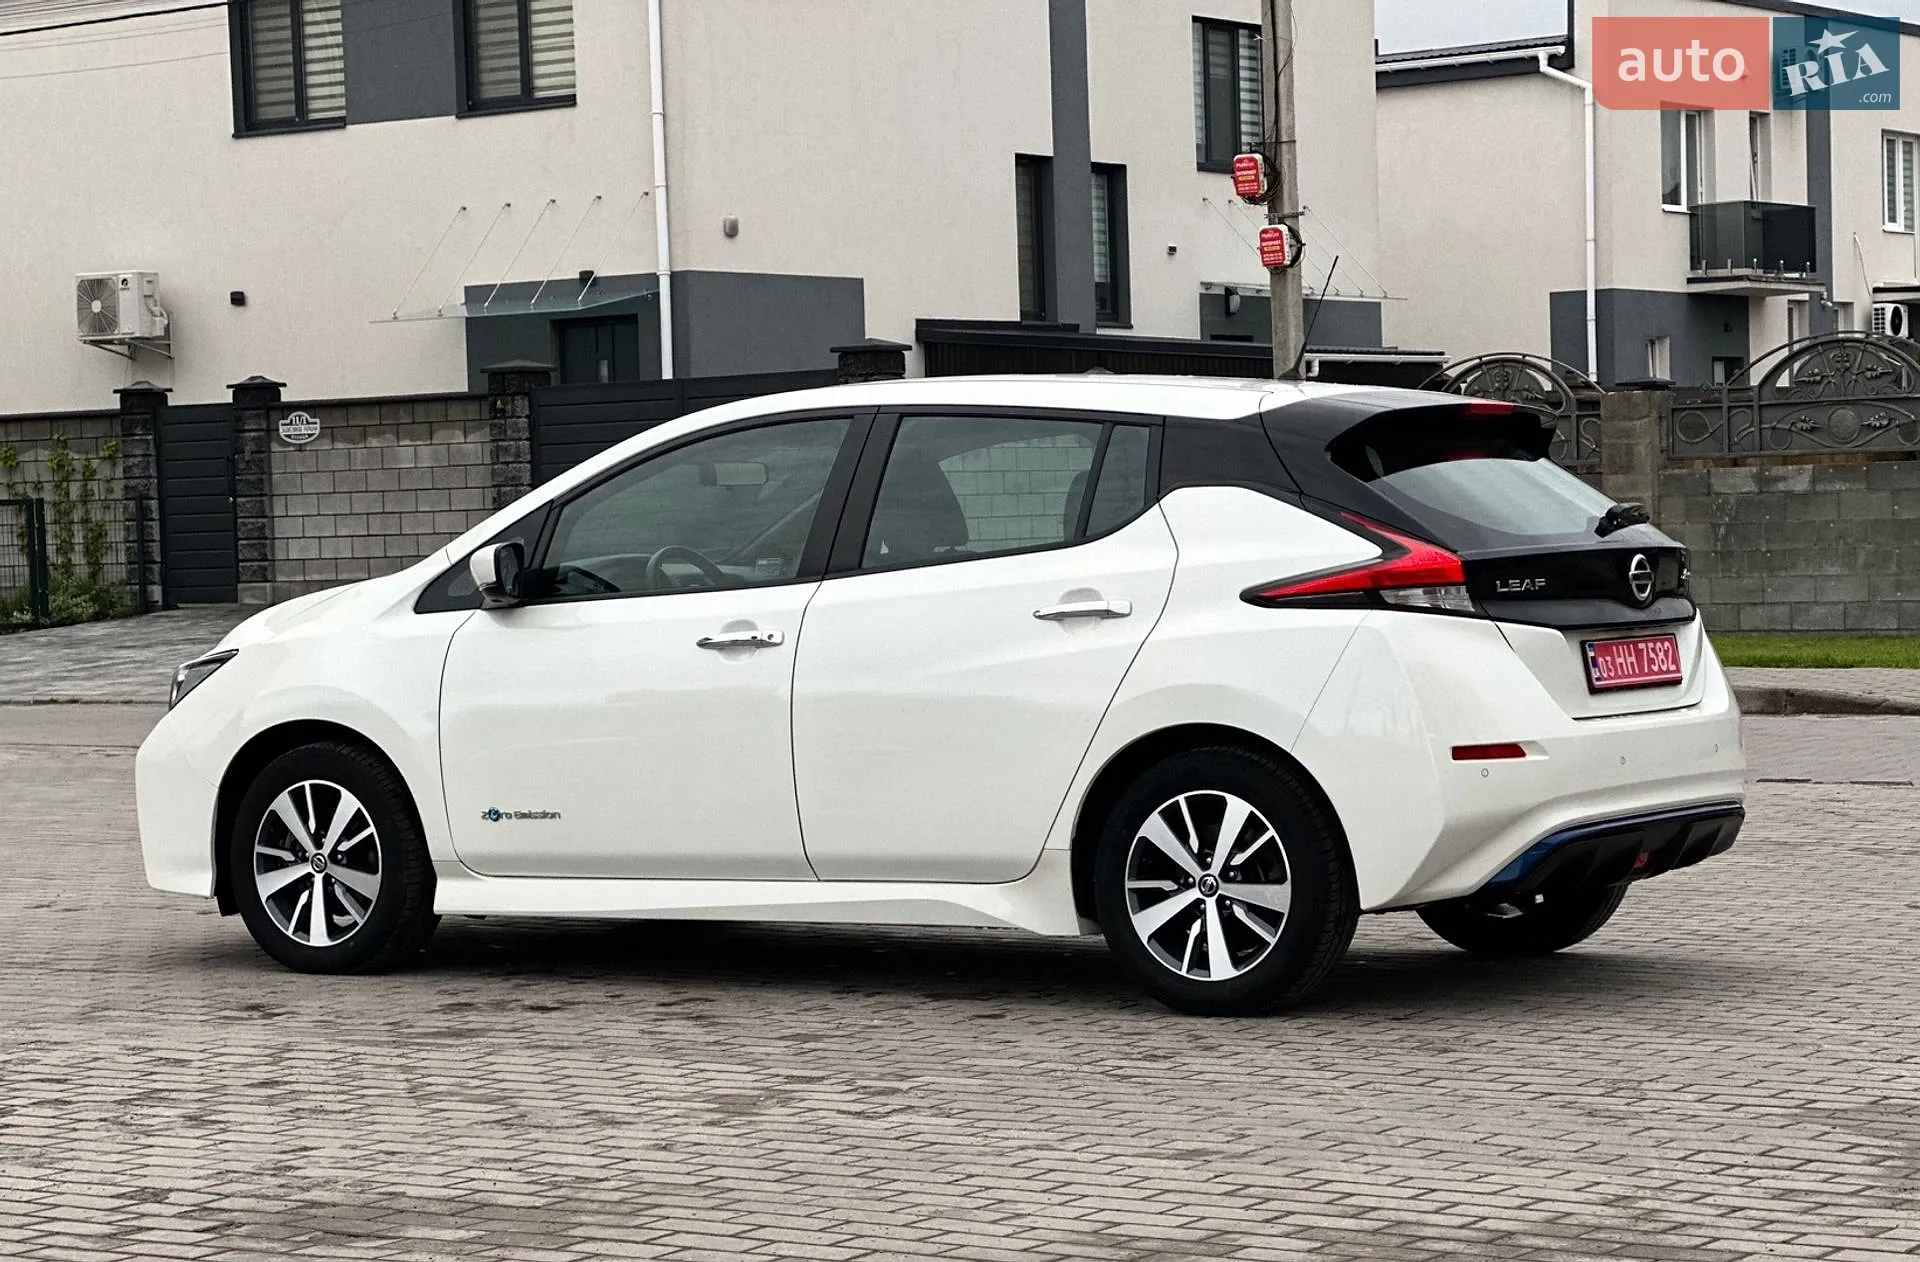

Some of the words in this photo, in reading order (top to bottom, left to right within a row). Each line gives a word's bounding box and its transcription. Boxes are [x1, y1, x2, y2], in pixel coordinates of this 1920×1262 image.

[1496, 578, 1546, 593] LEAF
[1598, 656, 1615, 678] 03
[1638, 641, 1677, 673] 7582
